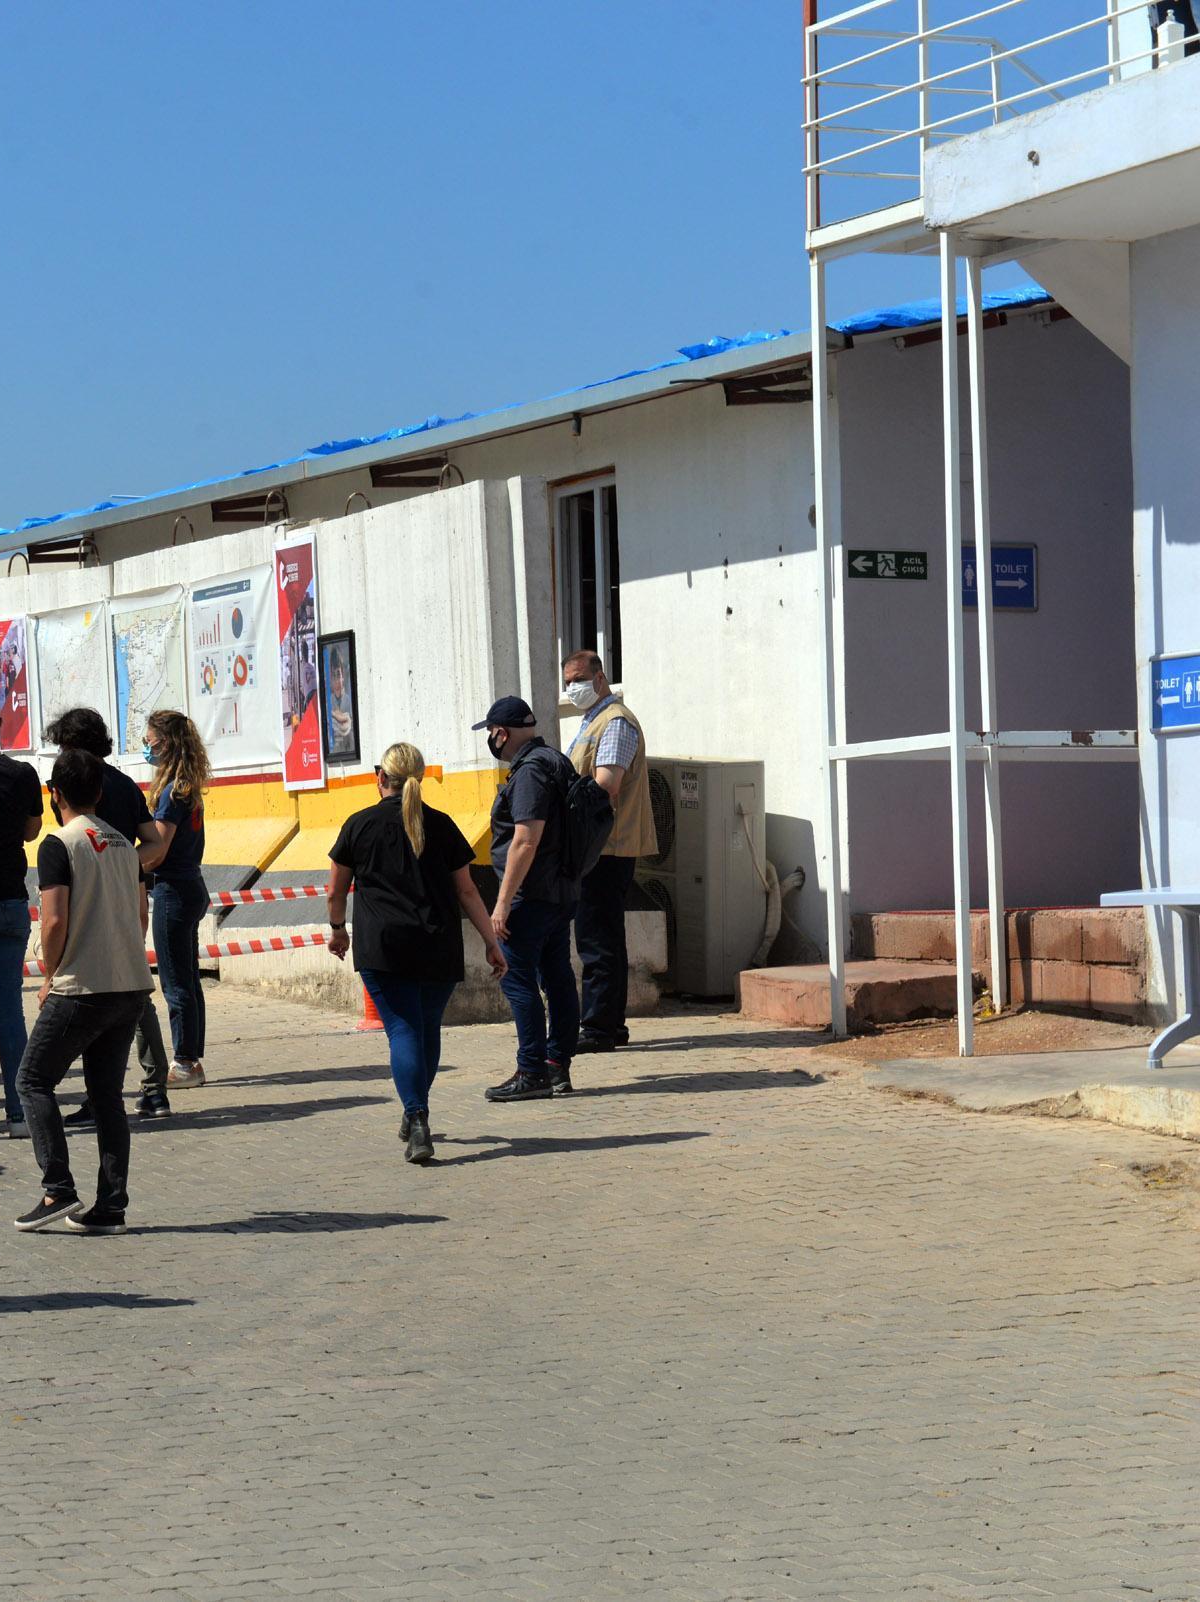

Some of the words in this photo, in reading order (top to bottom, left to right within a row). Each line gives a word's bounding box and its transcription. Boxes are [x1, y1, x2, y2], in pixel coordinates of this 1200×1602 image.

[901, 565, 925, 575] ÇIKIŞ
[994, 564, 1029, 574] TOILET
[1155, 677, 1180, 690] TOILET
